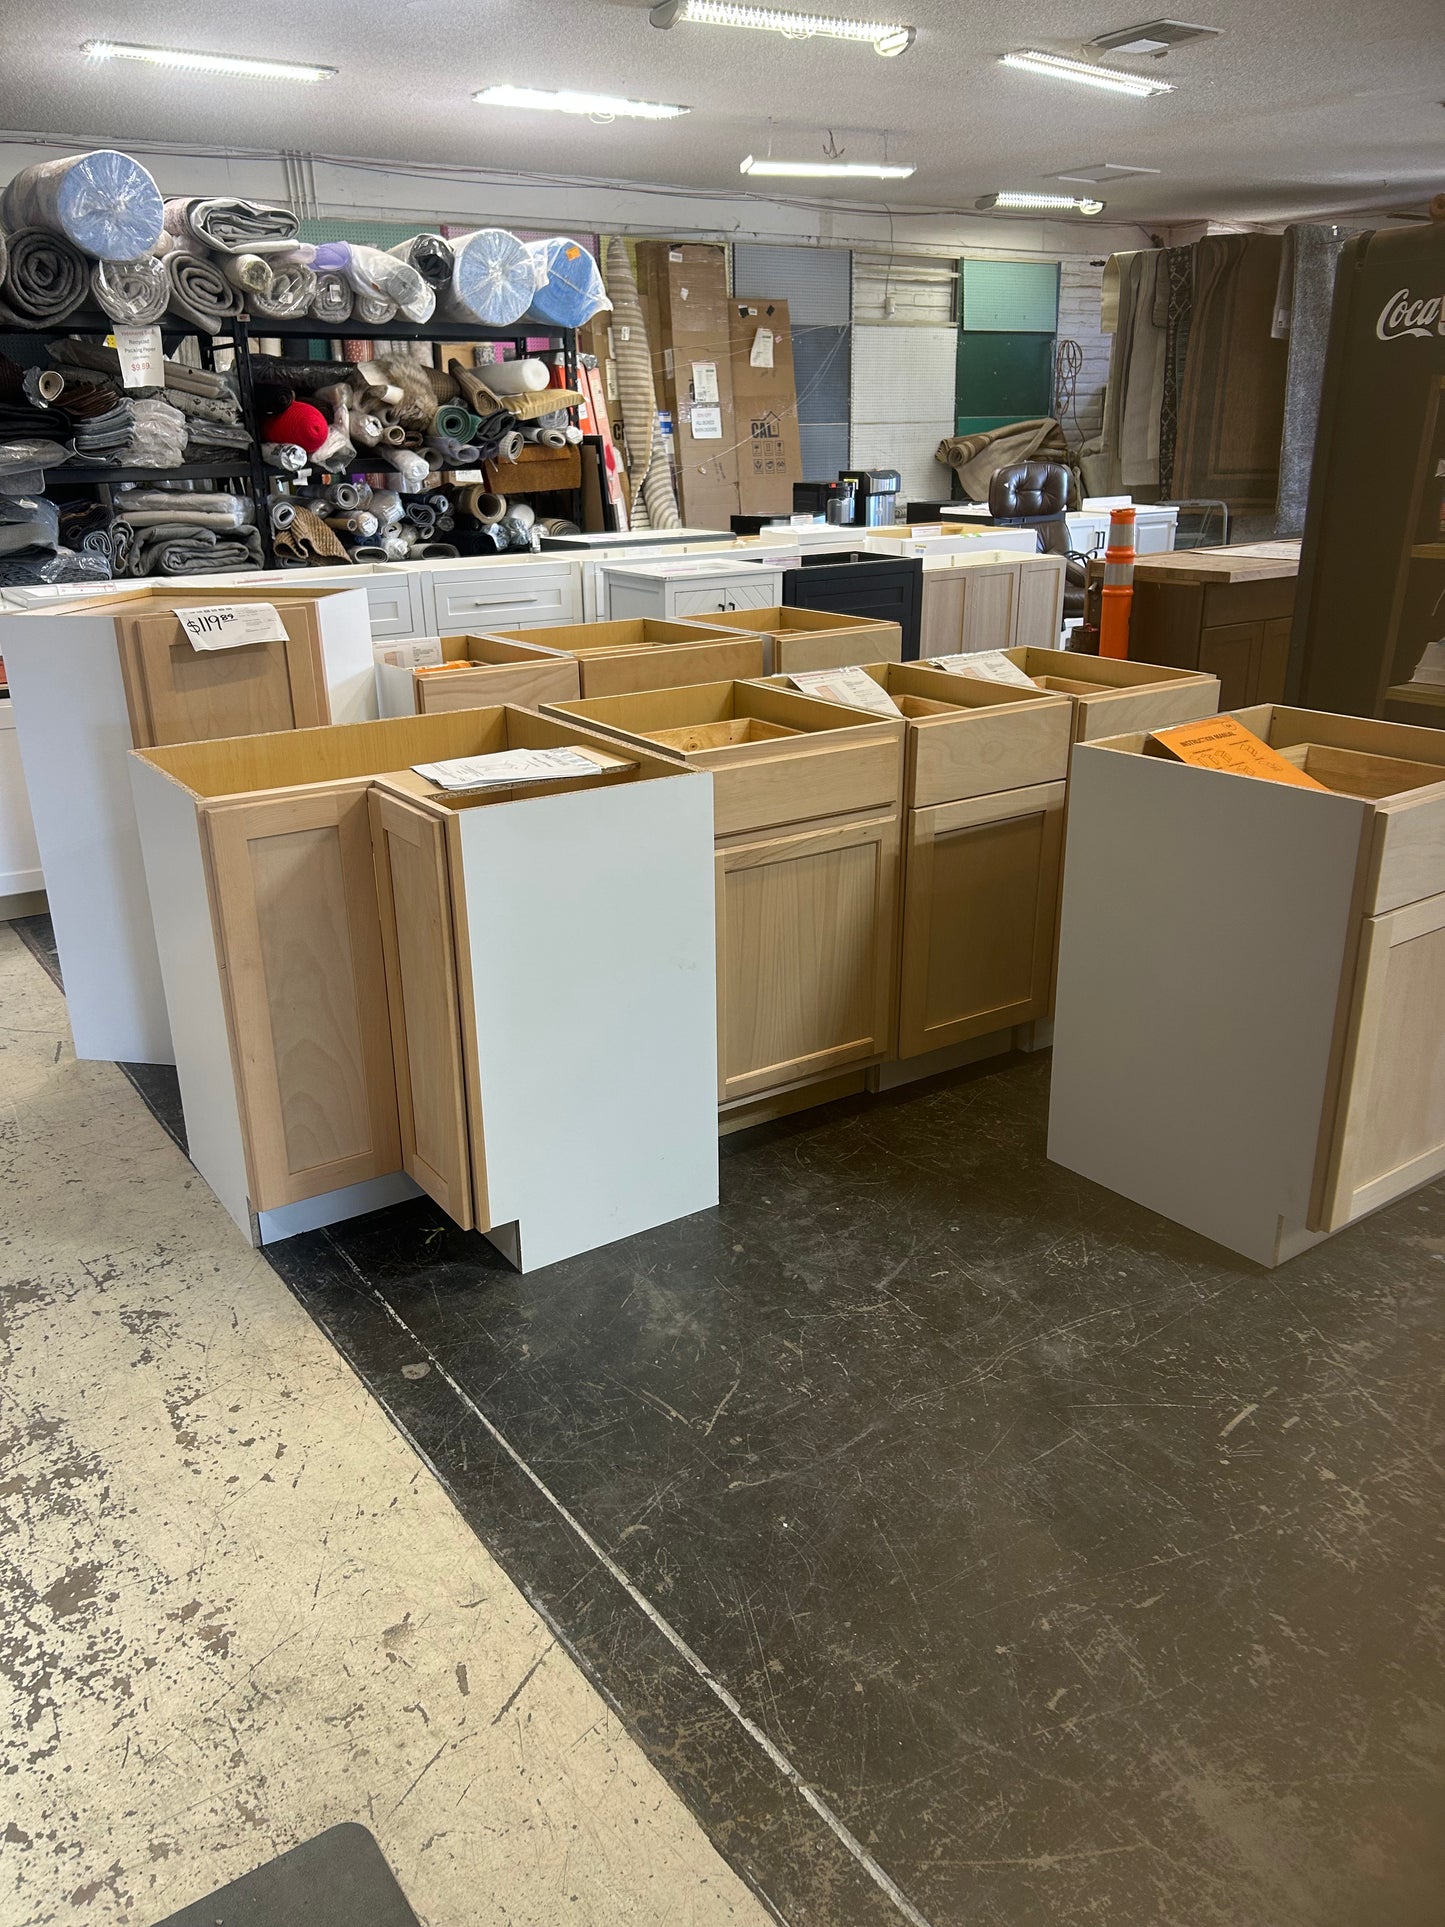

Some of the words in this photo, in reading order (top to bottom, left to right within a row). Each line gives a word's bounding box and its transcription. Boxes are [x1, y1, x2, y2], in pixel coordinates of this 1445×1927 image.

[1376, 288, 1442, 341] Coca
[128, 338, 150, 346] Recycled
[751, 422, 779, 439] CAL
[1180, 735, 1214, 747] INSTRUCTION
[1213, 731, 1237, 741] MANUAL
